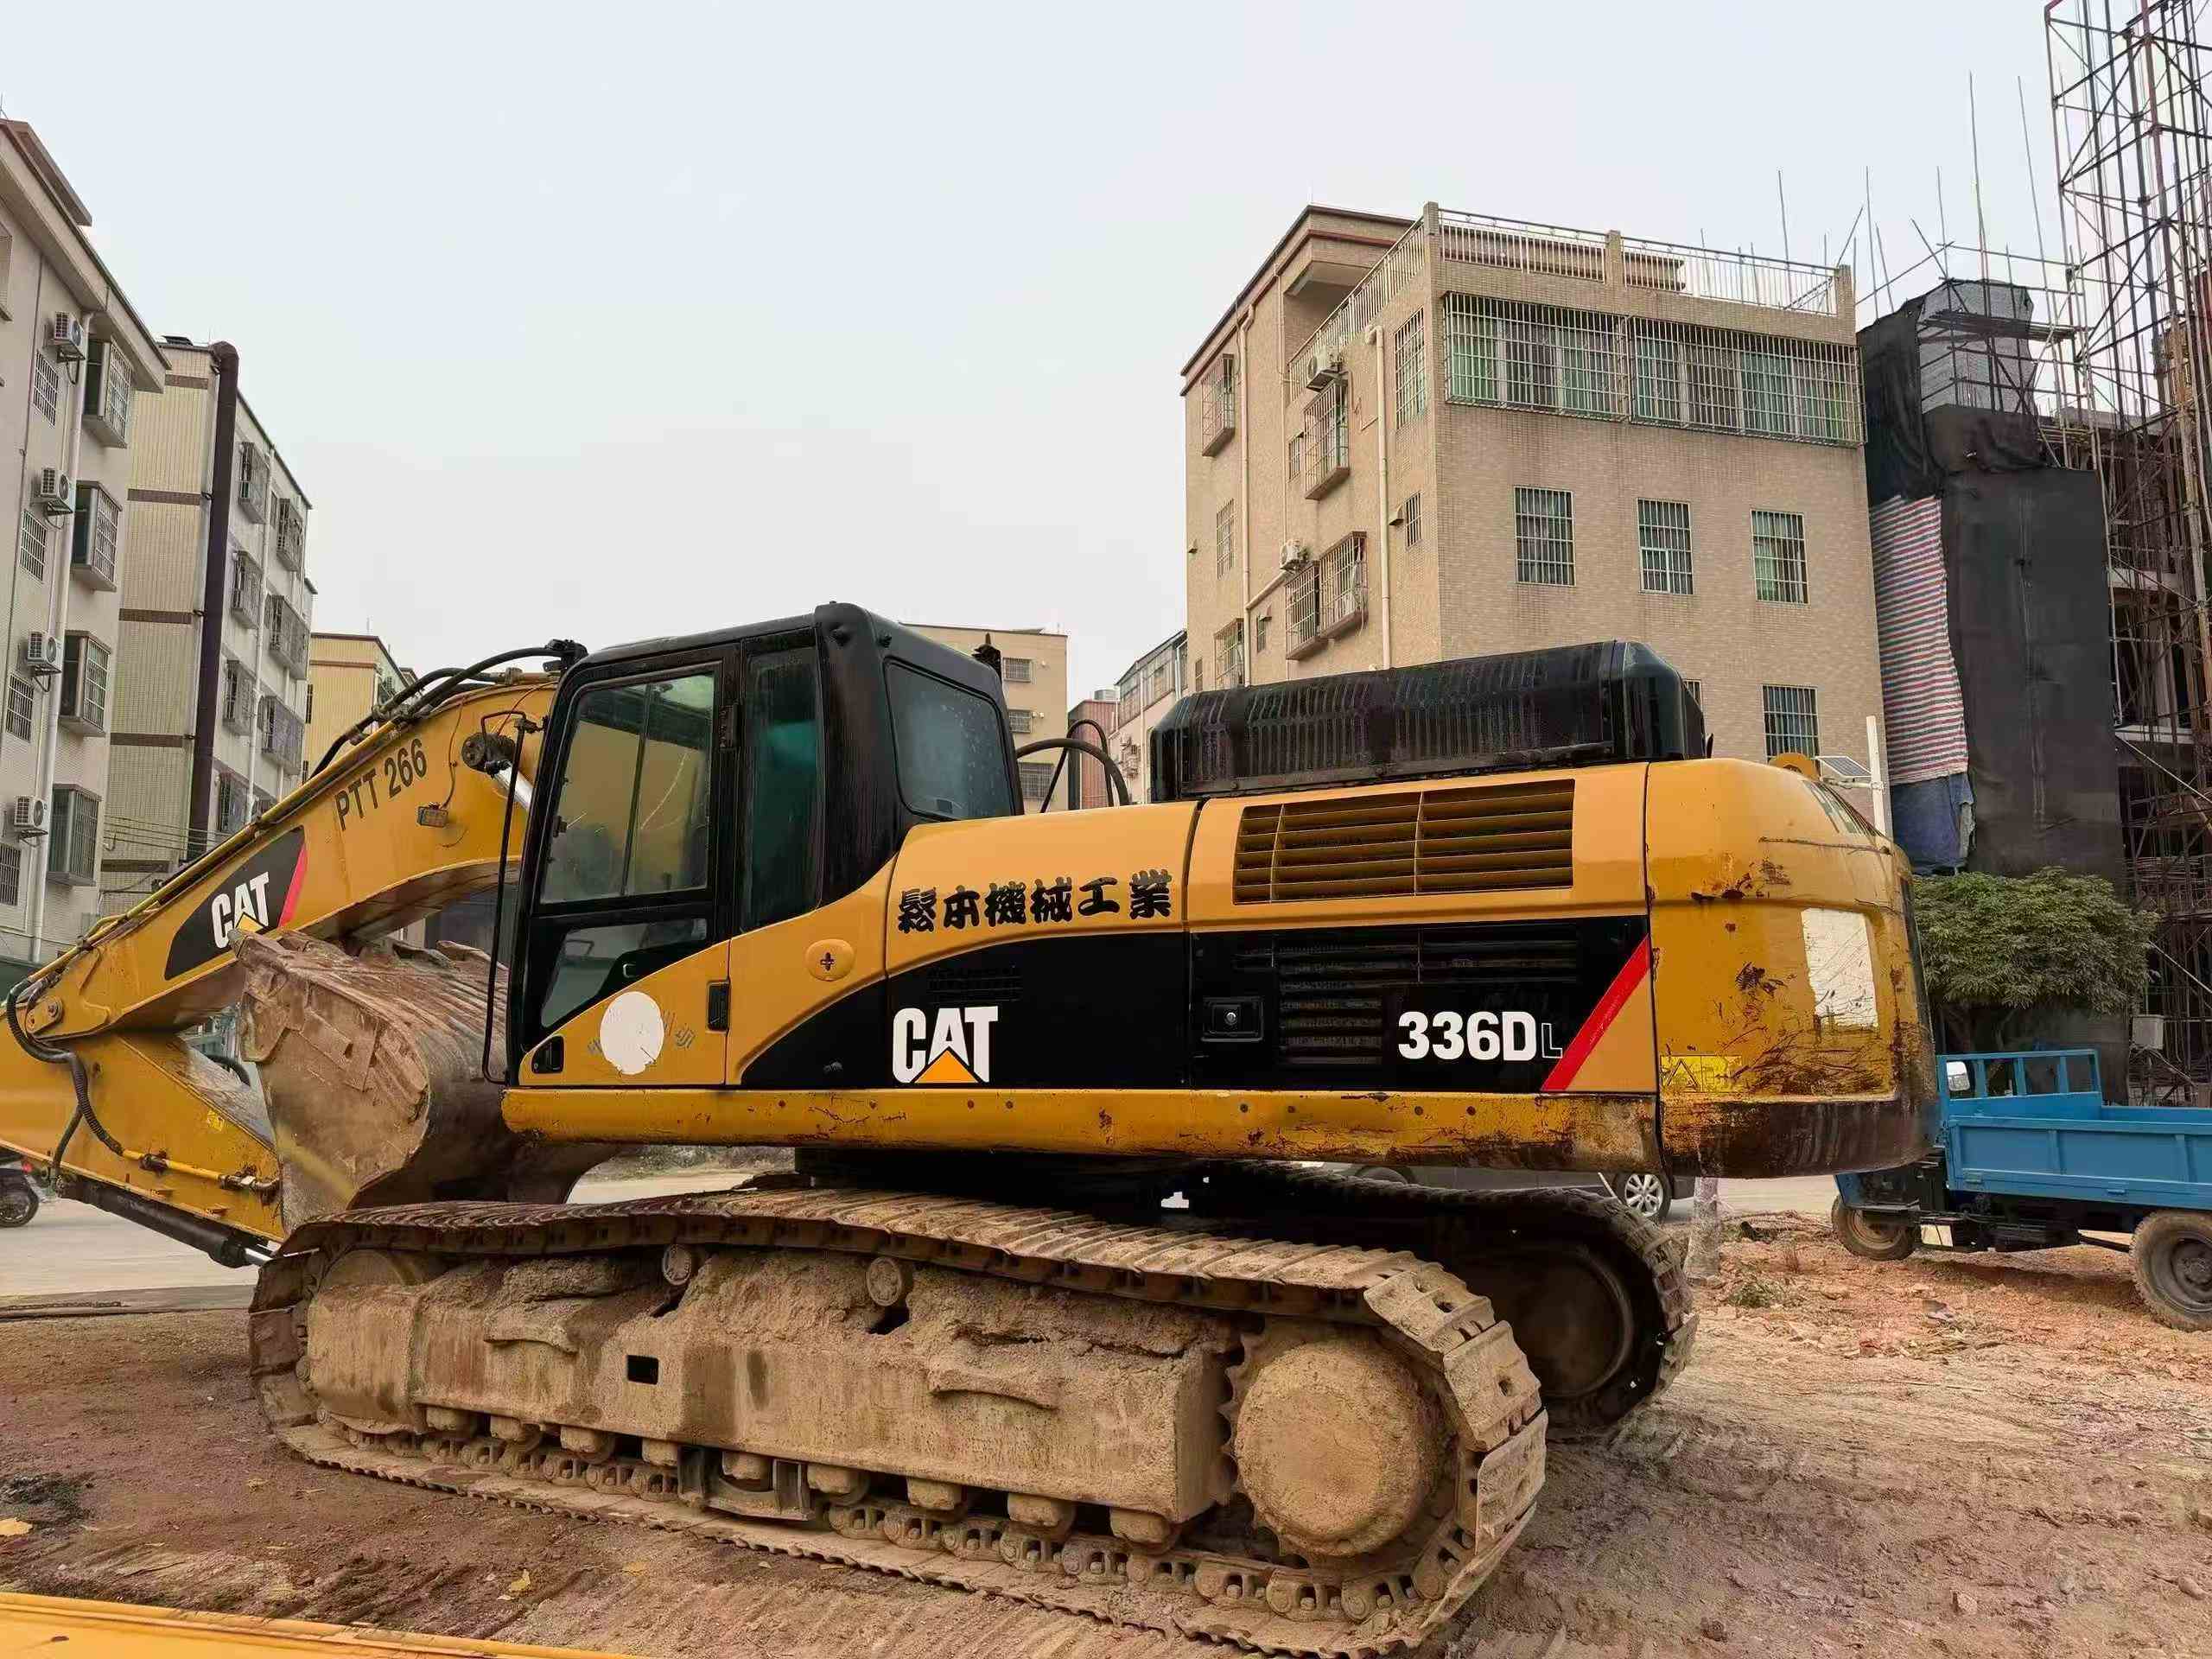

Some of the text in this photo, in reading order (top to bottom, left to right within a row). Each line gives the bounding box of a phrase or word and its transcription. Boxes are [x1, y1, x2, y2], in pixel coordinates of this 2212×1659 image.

[334, 739, 427, 831] PTT 266
[212, 871, 270, 949] CAT
[893, 1006, 998, 1084] CAT
